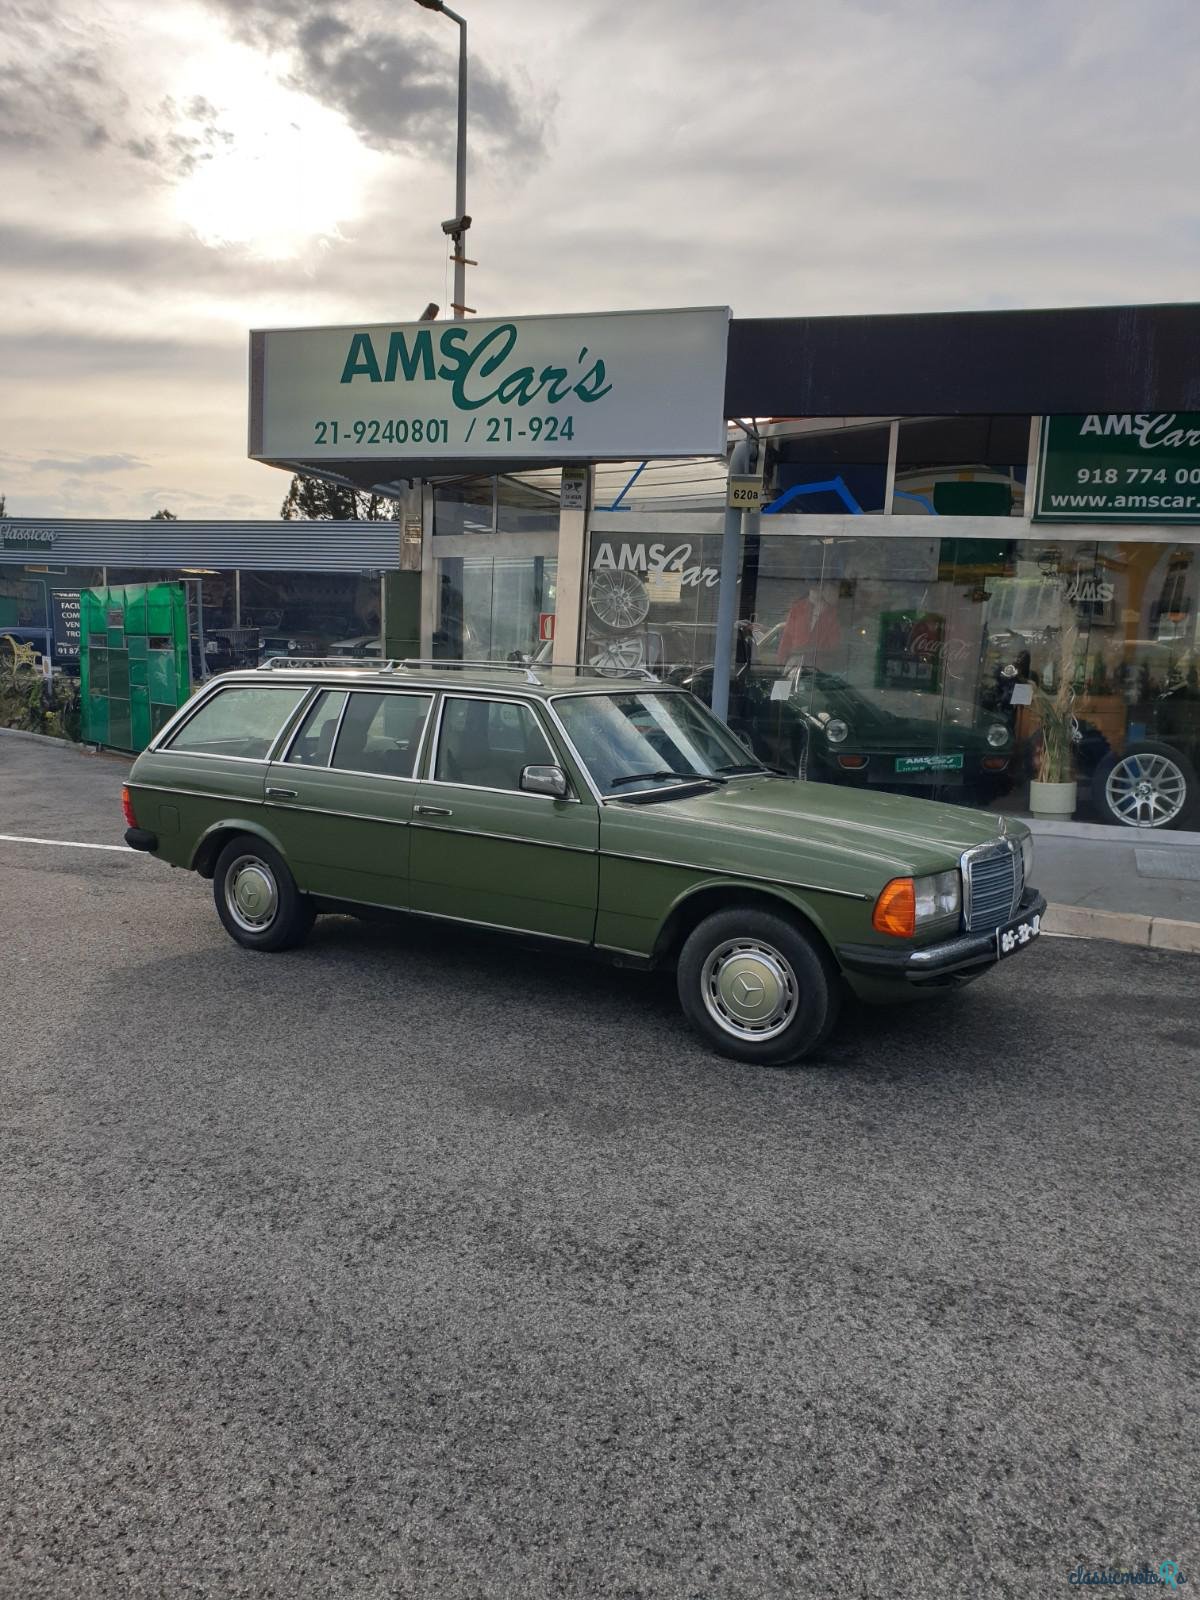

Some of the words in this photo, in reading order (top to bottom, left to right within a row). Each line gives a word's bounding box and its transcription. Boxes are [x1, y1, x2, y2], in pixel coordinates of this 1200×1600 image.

[340, 328, 468, 383] AMS
[452, 324, 613, 410] Car's
[314, 419, 449, 445] 21-9240801
[464, 417, 477, 443] /
[486, 416, 574, 442] 21-924
[1079, 414, 1149, 436] AMS
[1077, 468, 1118, 484] 918
[1126, 468, 1168, 484] 774
[733, 489, 759, 500] 620a
[593, 543, 665, 571] AMS
